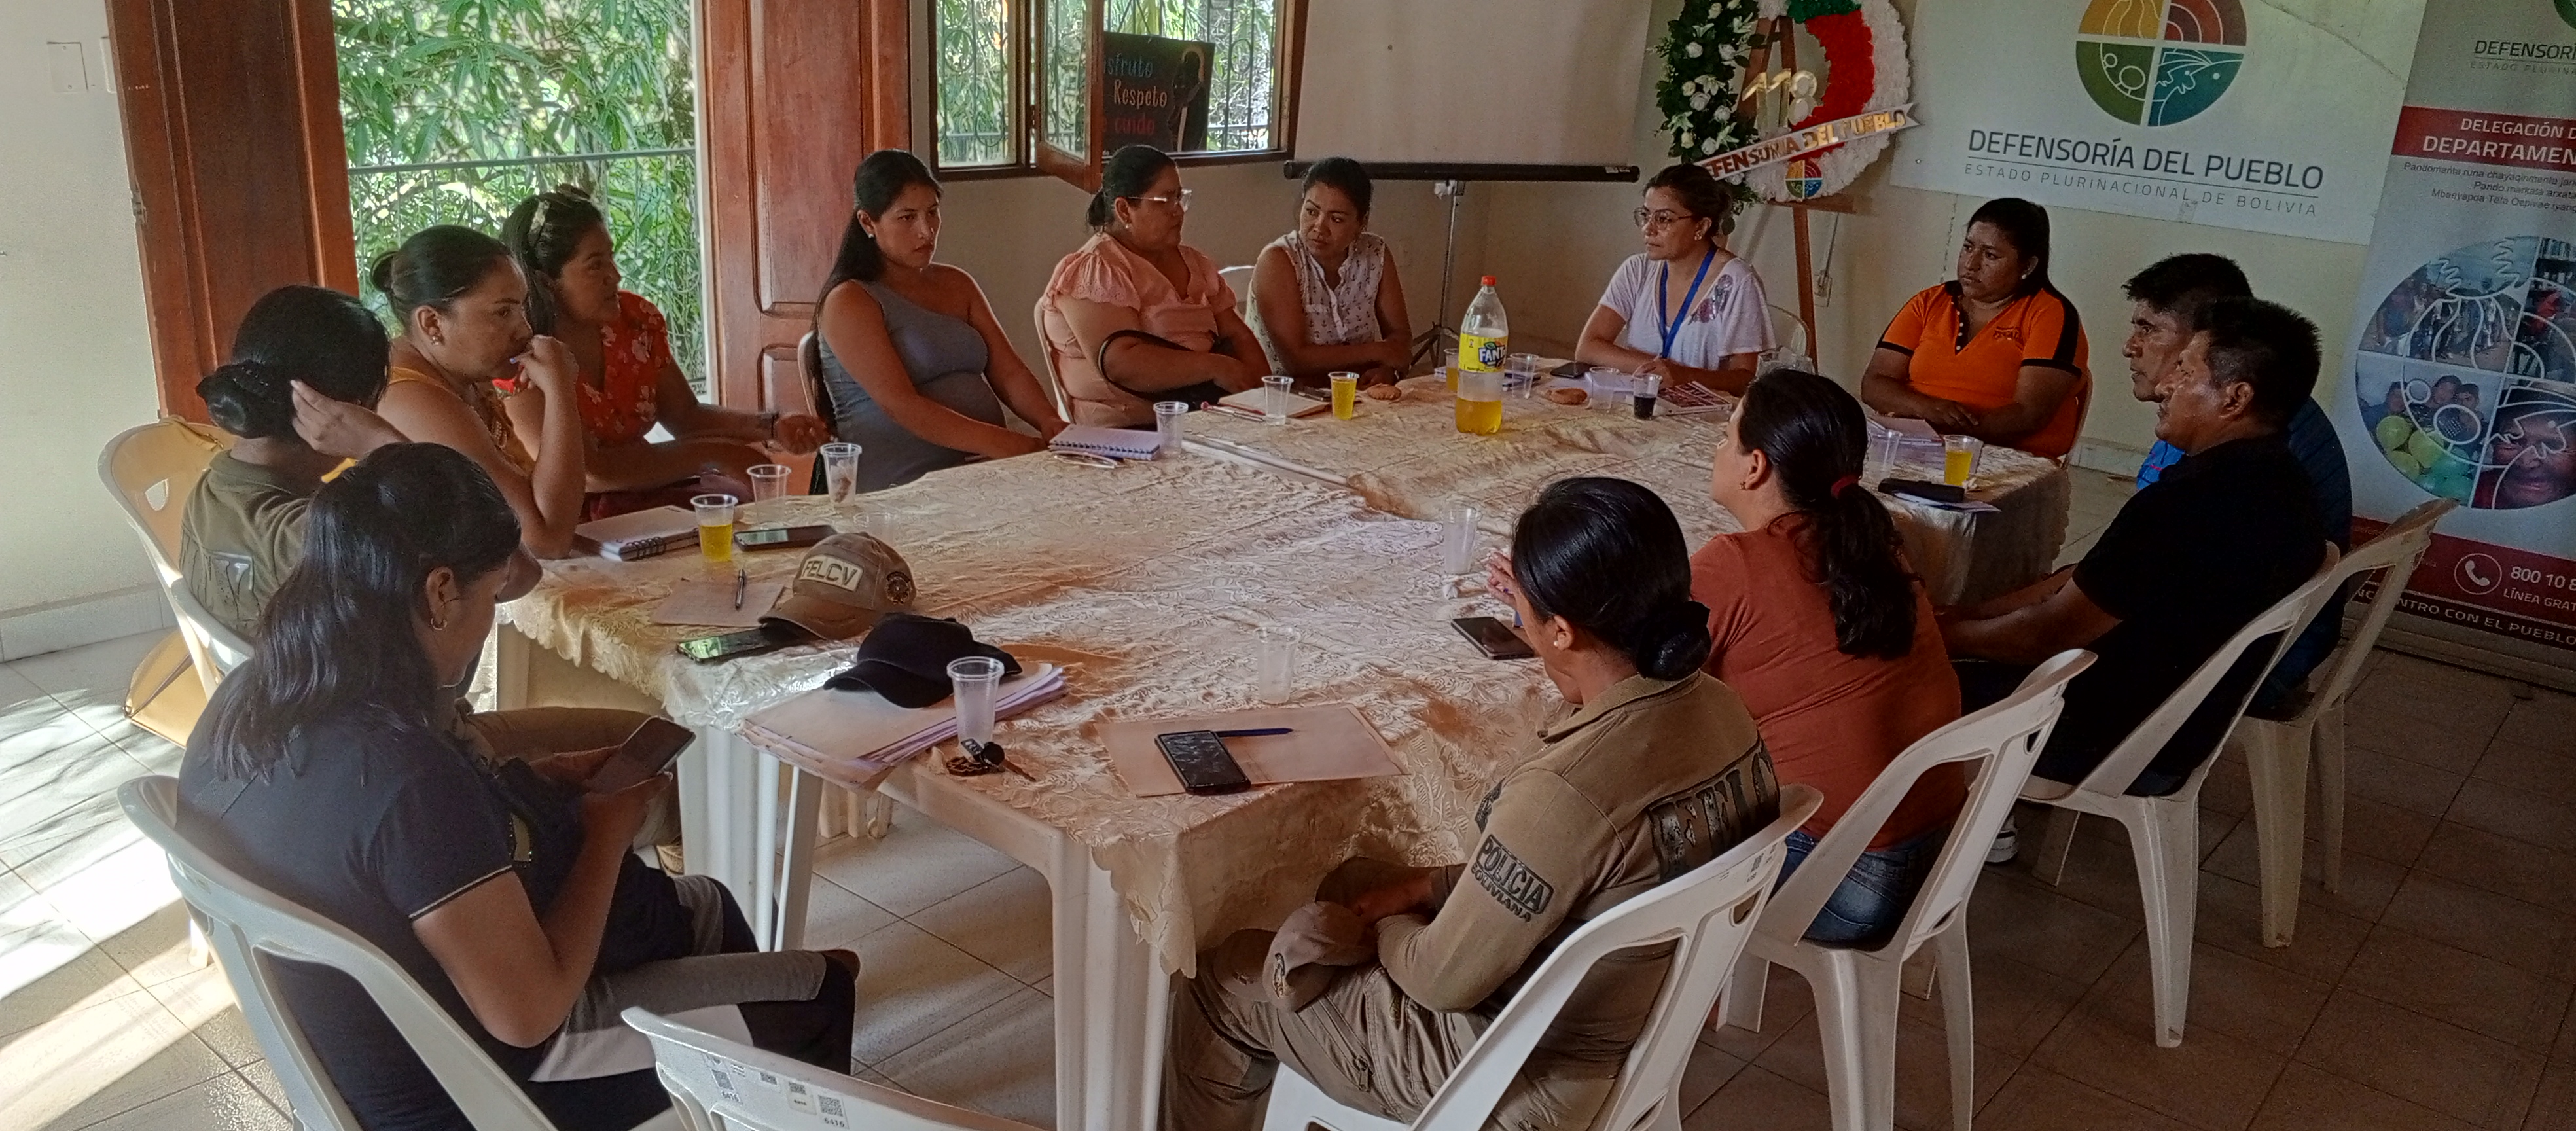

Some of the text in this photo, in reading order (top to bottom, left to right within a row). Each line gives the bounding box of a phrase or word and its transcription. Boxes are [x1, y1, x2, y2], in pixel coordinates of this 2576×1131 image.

[1114, 79, 1168, 110] Respeto
[1742, 67, 1818, 129] 118
[1802, 124, 1839, 149] DEL
[1840, 109, 1906, 139] PUEBLO
[2461, 118, 2564, 139] DELEGACIÓN
[1968, 129, 2323, 190] DEFENSORÍA DEL PUEBLO
[1965, 163, 2317, 217] ESTADO PLURINACIONAL DE BOLIVIA
[1479, 346, 1506, 363] FANT
[802, 560, 858, 585] FELCV
[2511, 566, 2541, 583] 800
[2546, 574, 2566, 588] 10
[2503, 587, 2541, 605] LÍNEA
[2445, 609, 2480, 624] CON
[2484, 617, 2503, 630] EL
[2509, 623, 2576, 645] PUEBLO
[1471, 861, 1532, 922] BOLIVIANA
[1478, 837, 1545, 912] POLICIA
